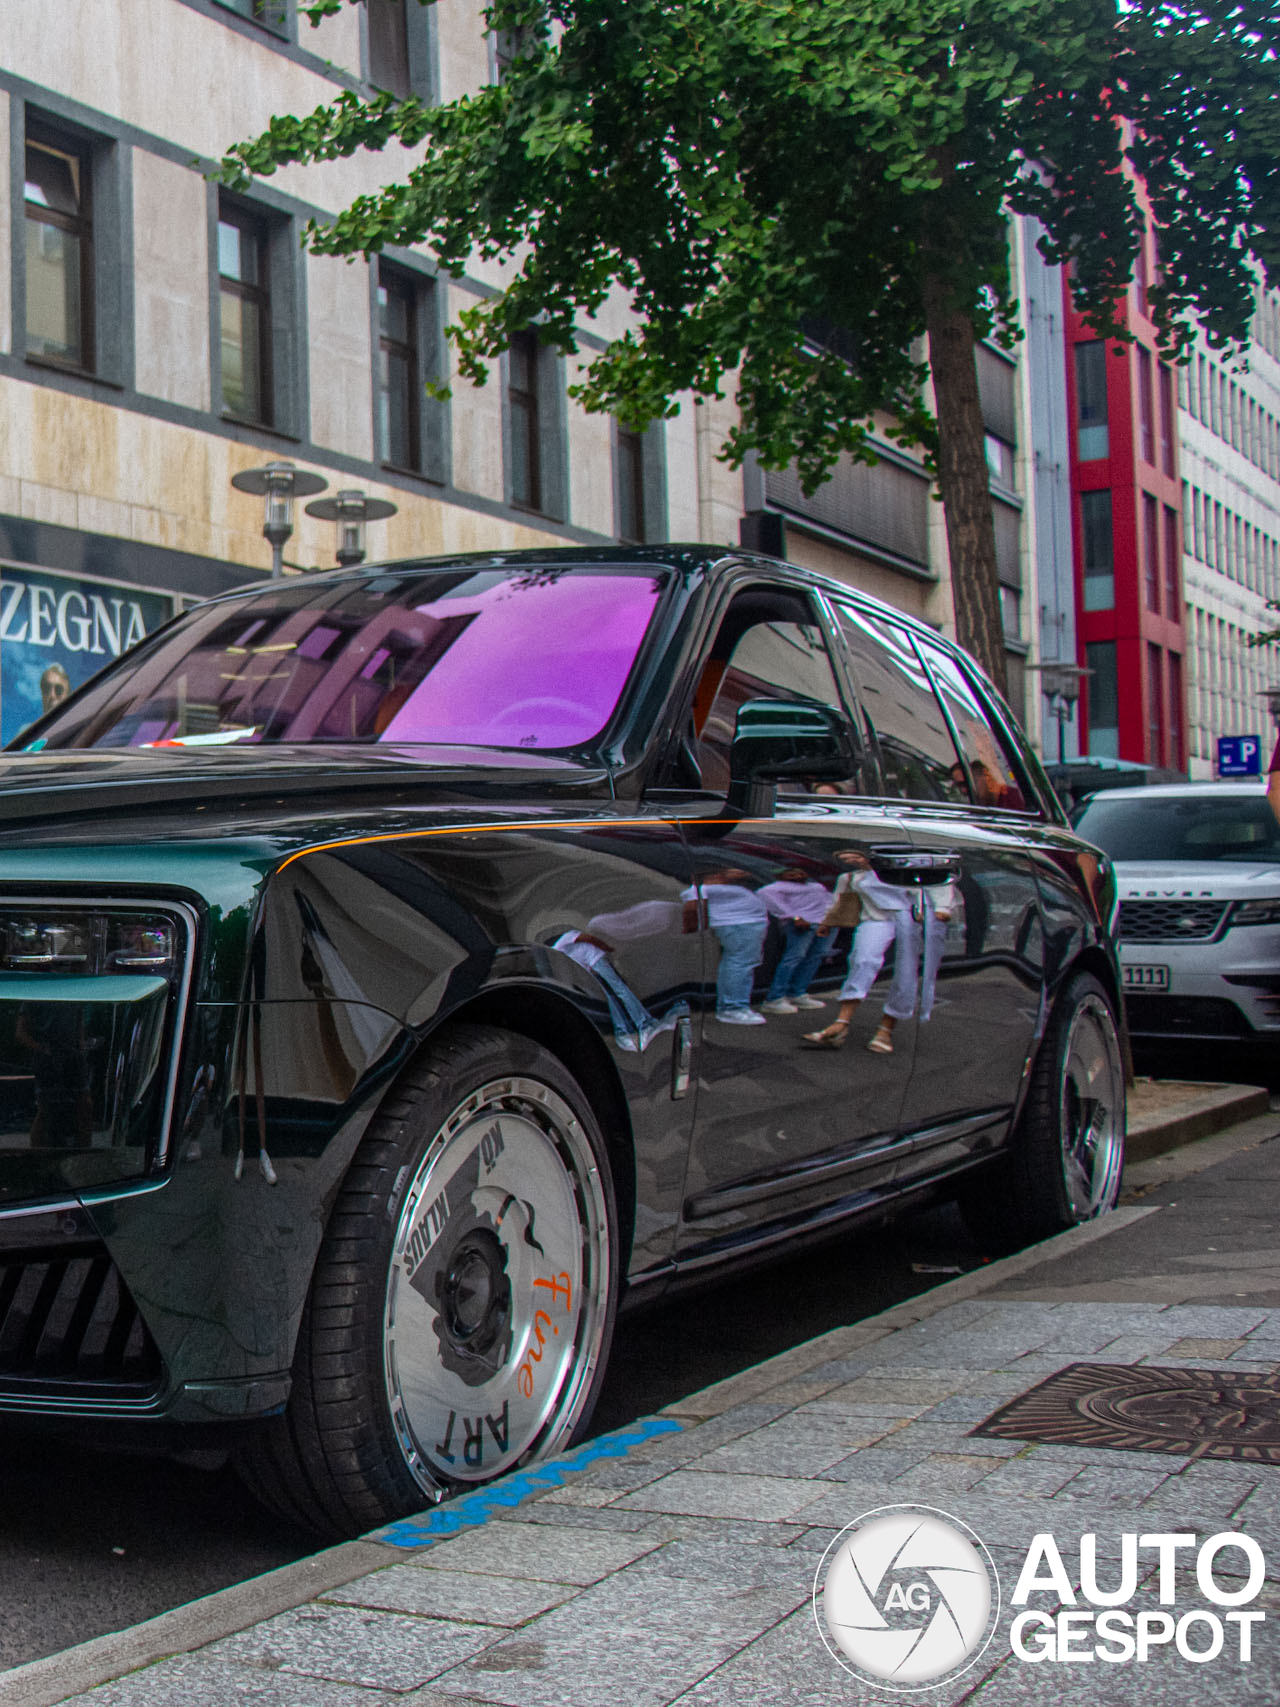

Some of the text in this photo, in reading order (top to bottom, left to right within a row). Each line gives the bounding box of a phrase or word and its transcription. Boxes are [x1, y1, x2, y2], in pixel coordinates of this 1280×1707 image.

[0, 580, 147, 656] ZEGNA
[1241, 742, 1256, 762] P
[1125, 967, 1166, 985] 1111
[403, 1188, 450, 1277] KLAUS
[517, 1271, 572, 1399] Fine
[435, 1399, 509, 1467] ART
